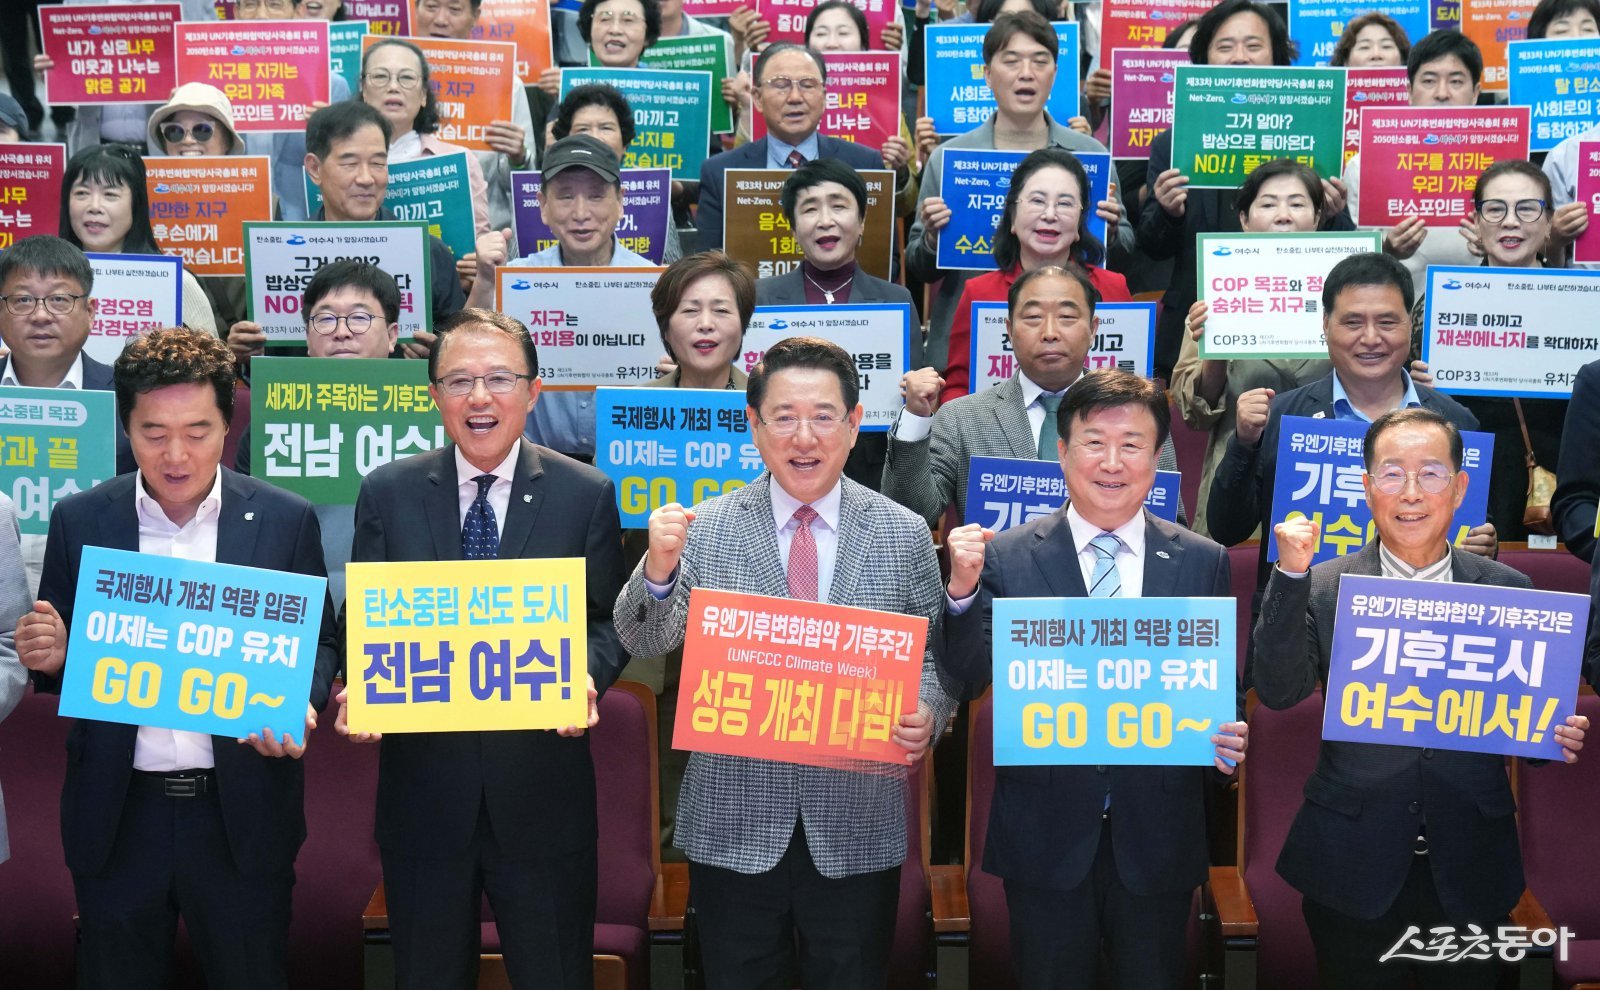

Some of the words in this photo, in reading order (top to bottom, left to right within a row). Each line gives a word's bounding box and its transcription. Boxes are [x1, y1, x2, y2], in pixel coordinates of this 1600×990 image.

[158, 11, 172, 21] 유치
[303, 32, 317, 40] 유치
[1128, 26, 1166, 42] 지구를
[68, 41, 95, 55] 내가
[1519, 50, 1542, 60] 제33차
[490, 53, 503, 62] 유치
[72, 59, 113, 74] 이웃과
[119, 58, 159, 73] 나누는
[209, 63, 251, 80] 지구를
[256, 63, 298, 79] 지키는
[86, 79, 113, 95] 맑은
[119, 78, 146, 93] 공기
[225, 84, 252, 99] 우리
[257, 84, 284, 99] 가족
[446, 82, 475, 97] 지구
[1186, 78, 1212, 87] 제33차
[1215, 78, 1315, 89] UN기후변화협약당사국총회
[1317, 79, 1333, 89] 유치
[1555, 78, 1570, 95] 탈
[1190, 94, 1225, 103] Net-Zero,
[1279, 96, 1331, 105] 앞장서겠습니다!
[280, 105, 307, 121] 가입
[1534, 101, 1593, 117] 사회로의
[634, 110, 679, 126] 아끼고
[827, 115, 870, 130] 나누는
[1226, 114, 1252, 129] 그거
[1257, 114, 1293, 130] 알아?
[1372, 119, 1398, 128] 제33차
[1401, 119, 1500, 129] UN기후변화협약당사국총회
[1502, 119, 1517, 127] 유치
[1203, 134, 1256, 150] 밥상으로
[1261, 135, 1315, 151] 돌아온다
[1373, 135, 1420, 144] 2050탄소중립,
[1470, 135, 1518, 144] 앞장서겠습니다!
[35, 155, 52, 164] 유치
[954, 161, 979, 170] 제33차
[1195, 154, 1235, 173] NO!!
[1397, 153, 1443, 170] 지구를
[1448, 153, 1494, 170] 지키는
[241, 168, 257, 177] 유치
[443, 164, 457, 175] 유치
[646, 180, 659, 190] 유치
[736, 181, 762, 190] 제33차
[866, 182, 881, 191] 유치
[955, 177, 990, 186] Net-Zero,
[1413, 176, 1442, 192] 우리
[1449, 175, 1477, 193] 가족
[737, 197, 773, 206] Net-Zero,
[1388, 199, 1464, 216] 탄소포인트
[196, 202, 227, 218] 지구
[394, 200, 443, 220] 아끼고
[153, 224, 218, 241] 후손에게
[295, 256, 329, 272] 그거
[534, 281, 558, 289] 여수시
[1212, 277, 1248, 292] COP
[1255, 276, 1302, 293] 목표와
[1213, 297, 1264, 313] 숨쉬는
[1270, 297, 1317, 313] 지구를
[531, 310, 578, 326] 지구는
[1438, 312, 1478, 326] 전기를
[1482, 314, 1522, 328] 아끼고
[531, 331, 588, 347] 1회용이
[593, 334, 645, 347] 아닙니다
[1214, 335, 1256, 345] COP33
[1437, 329, 1539, 349] 재생에너지를
[1544, 337, 1598, 351] 확대하자
[1436, 370, 1481, 382] COP33
[265, 383, 312, 412] 세계가
[317, 384, 377, 412] 주목하는
[0, 404, 43, 420] 소중립
[49, 406, 78, 421] 목표
[612, 405, 675, 431] 국제행사
[680, 407, 711, 432] 개최
[717, 408, 749, 434] 역량
[865, 410, 878, 419] 유치
[882, 410, 897, 419] 기원
[264, 423, 343, 477] 전남
[1291, 433, 1365, 457] 유엔기후변
[48, 438, 78, 469] 끝
[610, 439, 677, 467] 이제는
[685, 441, 731, 468] COP
[980, 473, 1070, 496] 유엔기후변화
[620, 476, 677, 515] GO
[96, 568, 172, 607] 국제행사
[178, 579, 216, 612] 개최
[221, 586, 260, 619] 역량
[264, 591, 307, 625] 입증!
[364, 586, 459, 628] 탄소중립
[468, 585, 514, 625] 선도
[523, 584, 569, 624] 도시
[1351, 594, 1485, 625] 유엔기후변화협약
[1488, 604, 1573, 634] 기후주간은
[86, 610, 168, 651] 이제는
[177, 622, 233, 655] COP
[240, 631, 299, 668] 유치
[701, 605, 840, 656] 유엔기후변화협약
[842, 621, 914, 661] 기후주간
[1011, 618, 1086, 647] 국제행사
[1091, 618, 1128, 647] 개최
[1134, 618, 1172, 647] 역량
[1178, 618, 1219, 647] 입증!
[727, 648, 782, 667] (UNFCCC
[785, 654, 832, 674] Climate
[836, 661, 877, 680] Week)
[1352, 627, 1547, 688] 기후도시
[363, 640, 455, 704] 전남
[469, 637, 570, 701] 여수!
[1008, 659, 1087, 690] 이제는
[1097, 659, 1149, 690] COP
[1160, 659, 1217, 691] 유치
[92, 657, 162, 709] GO
[692, 669, 755, 736] 성공
[759, 677, 824, 746] 개최
[1340, 680, 1559, 744] 여수에서!
[1023, 702, 1088, 749] GO
